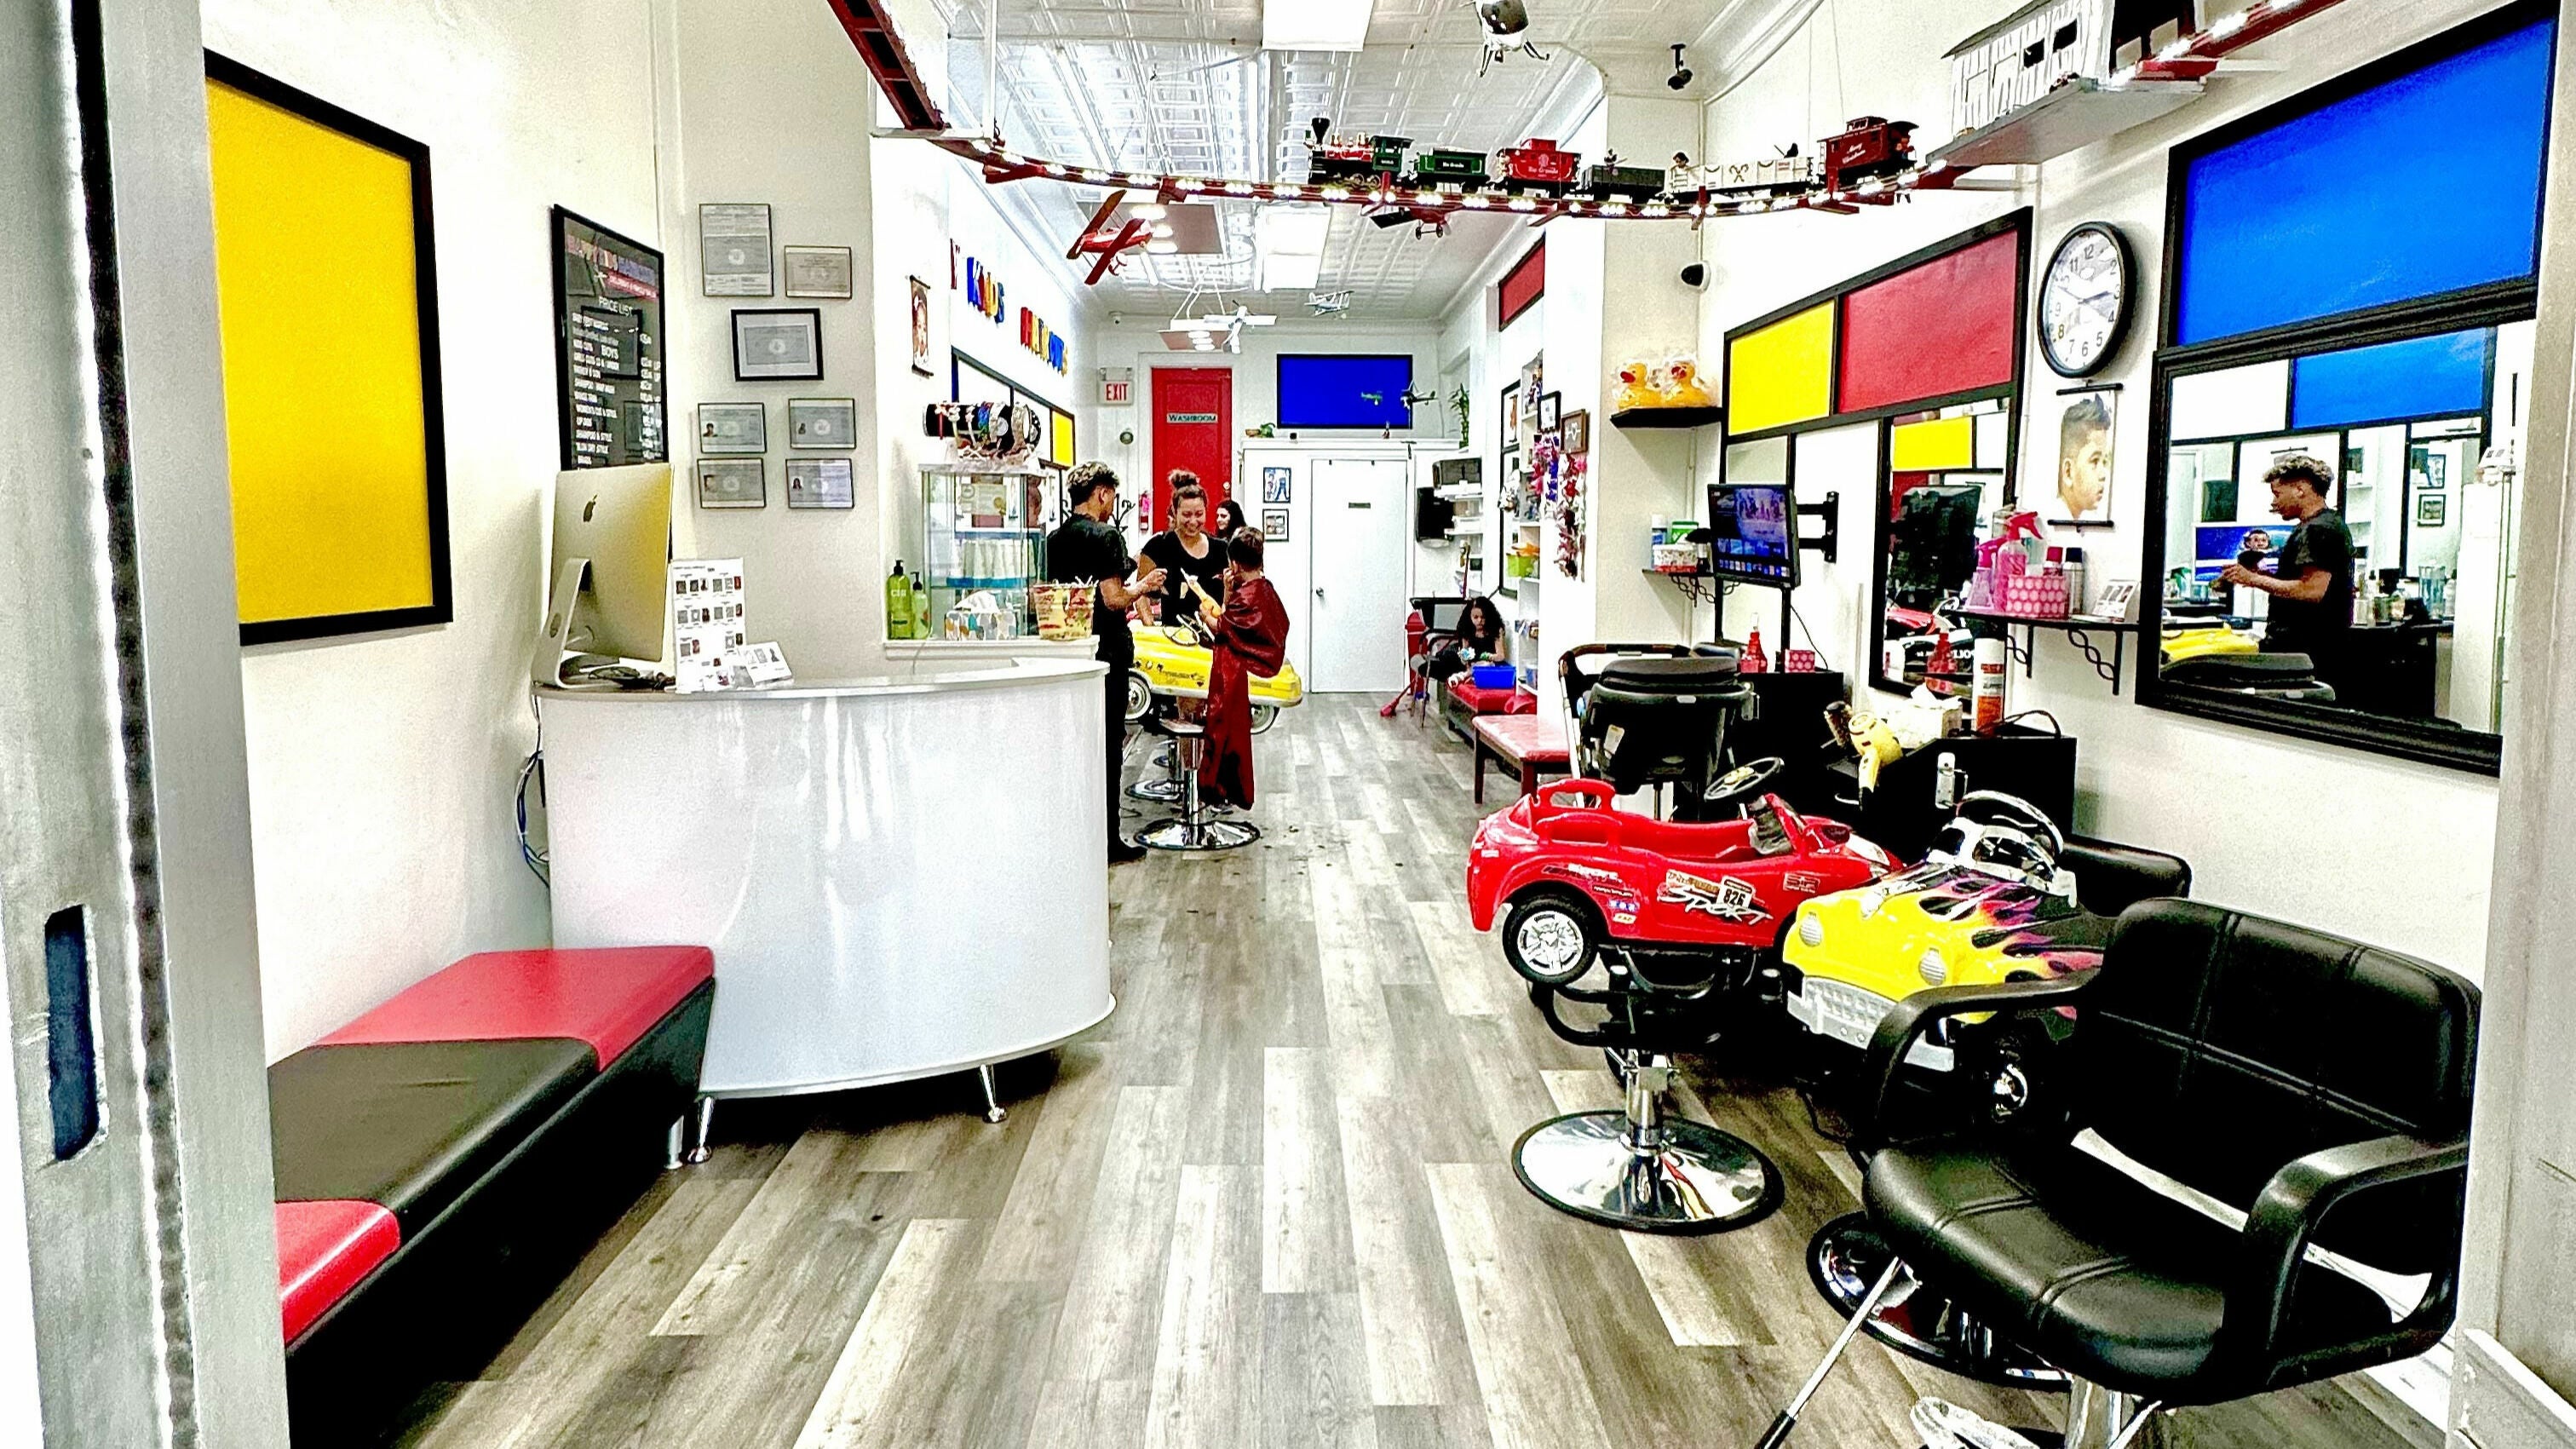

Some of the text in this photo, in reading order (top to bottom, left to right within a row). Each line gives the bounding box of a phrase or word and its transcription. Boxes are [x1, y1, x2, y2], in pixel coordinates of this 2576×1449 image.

[2084, 244, 2094, 260] 12
[2069, 258, 2079, 273] 11
[2110, 259, 2117, 275] 2
[598, 296, 634, 317] PRICE LIST
[2055, 302, 2061, 317] 9
[2108, 310, 2114, 323] 4
[2058, 325, 2064, 340] 8
[2096, 331, 2103, 347] 5
[2069, 339, 2075, 354] 7
[2081, 342, 2089, 357] 6
[1106, 383, 1129, 401] EXIT
[1722, 888, 1746, 906] 826
[1658, 888, 1774, 925] SPORT
